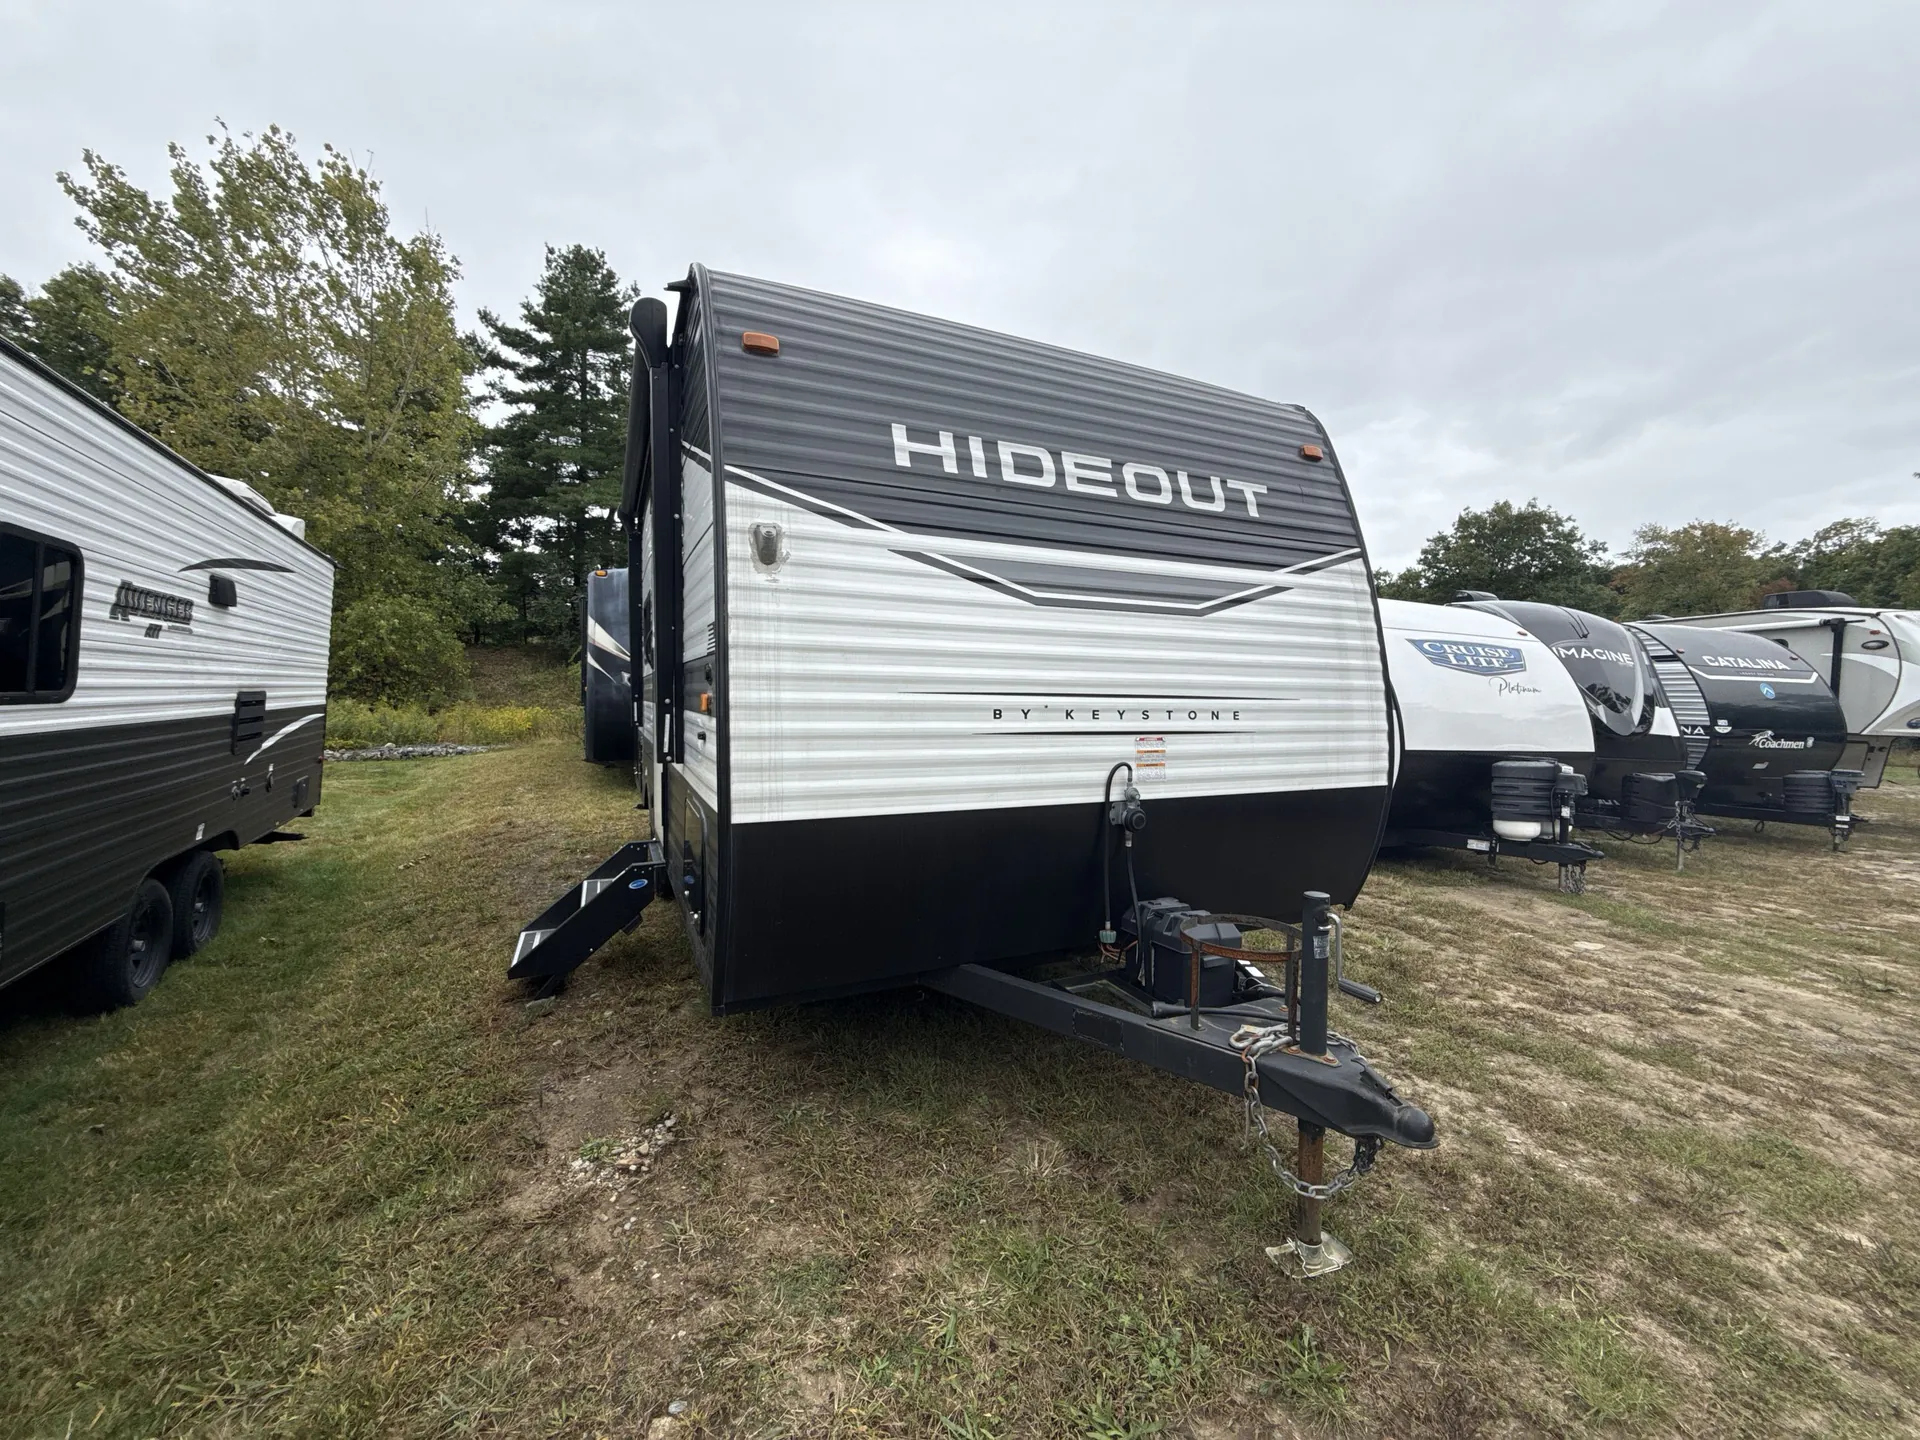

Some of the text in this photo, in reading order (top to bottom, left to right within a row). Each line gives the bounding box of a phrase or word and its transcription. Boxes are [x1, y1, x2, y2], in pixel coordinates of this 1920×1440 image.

[891, 423, 1268, 518] HIDEOUT
[1423, 641, 1515, 659] CRUISE
[1552, 646, 1634, 666] IMAGINE
[1447, 653, 1508, 668] LITE
[1702, 655, 1791, 670] CATALINA
[1488, 676, 1541, 697] Platinum
[993, 709, 1240, 721] BY KEYSTONE
[1759, 738, 1805, 749] Coachmen
